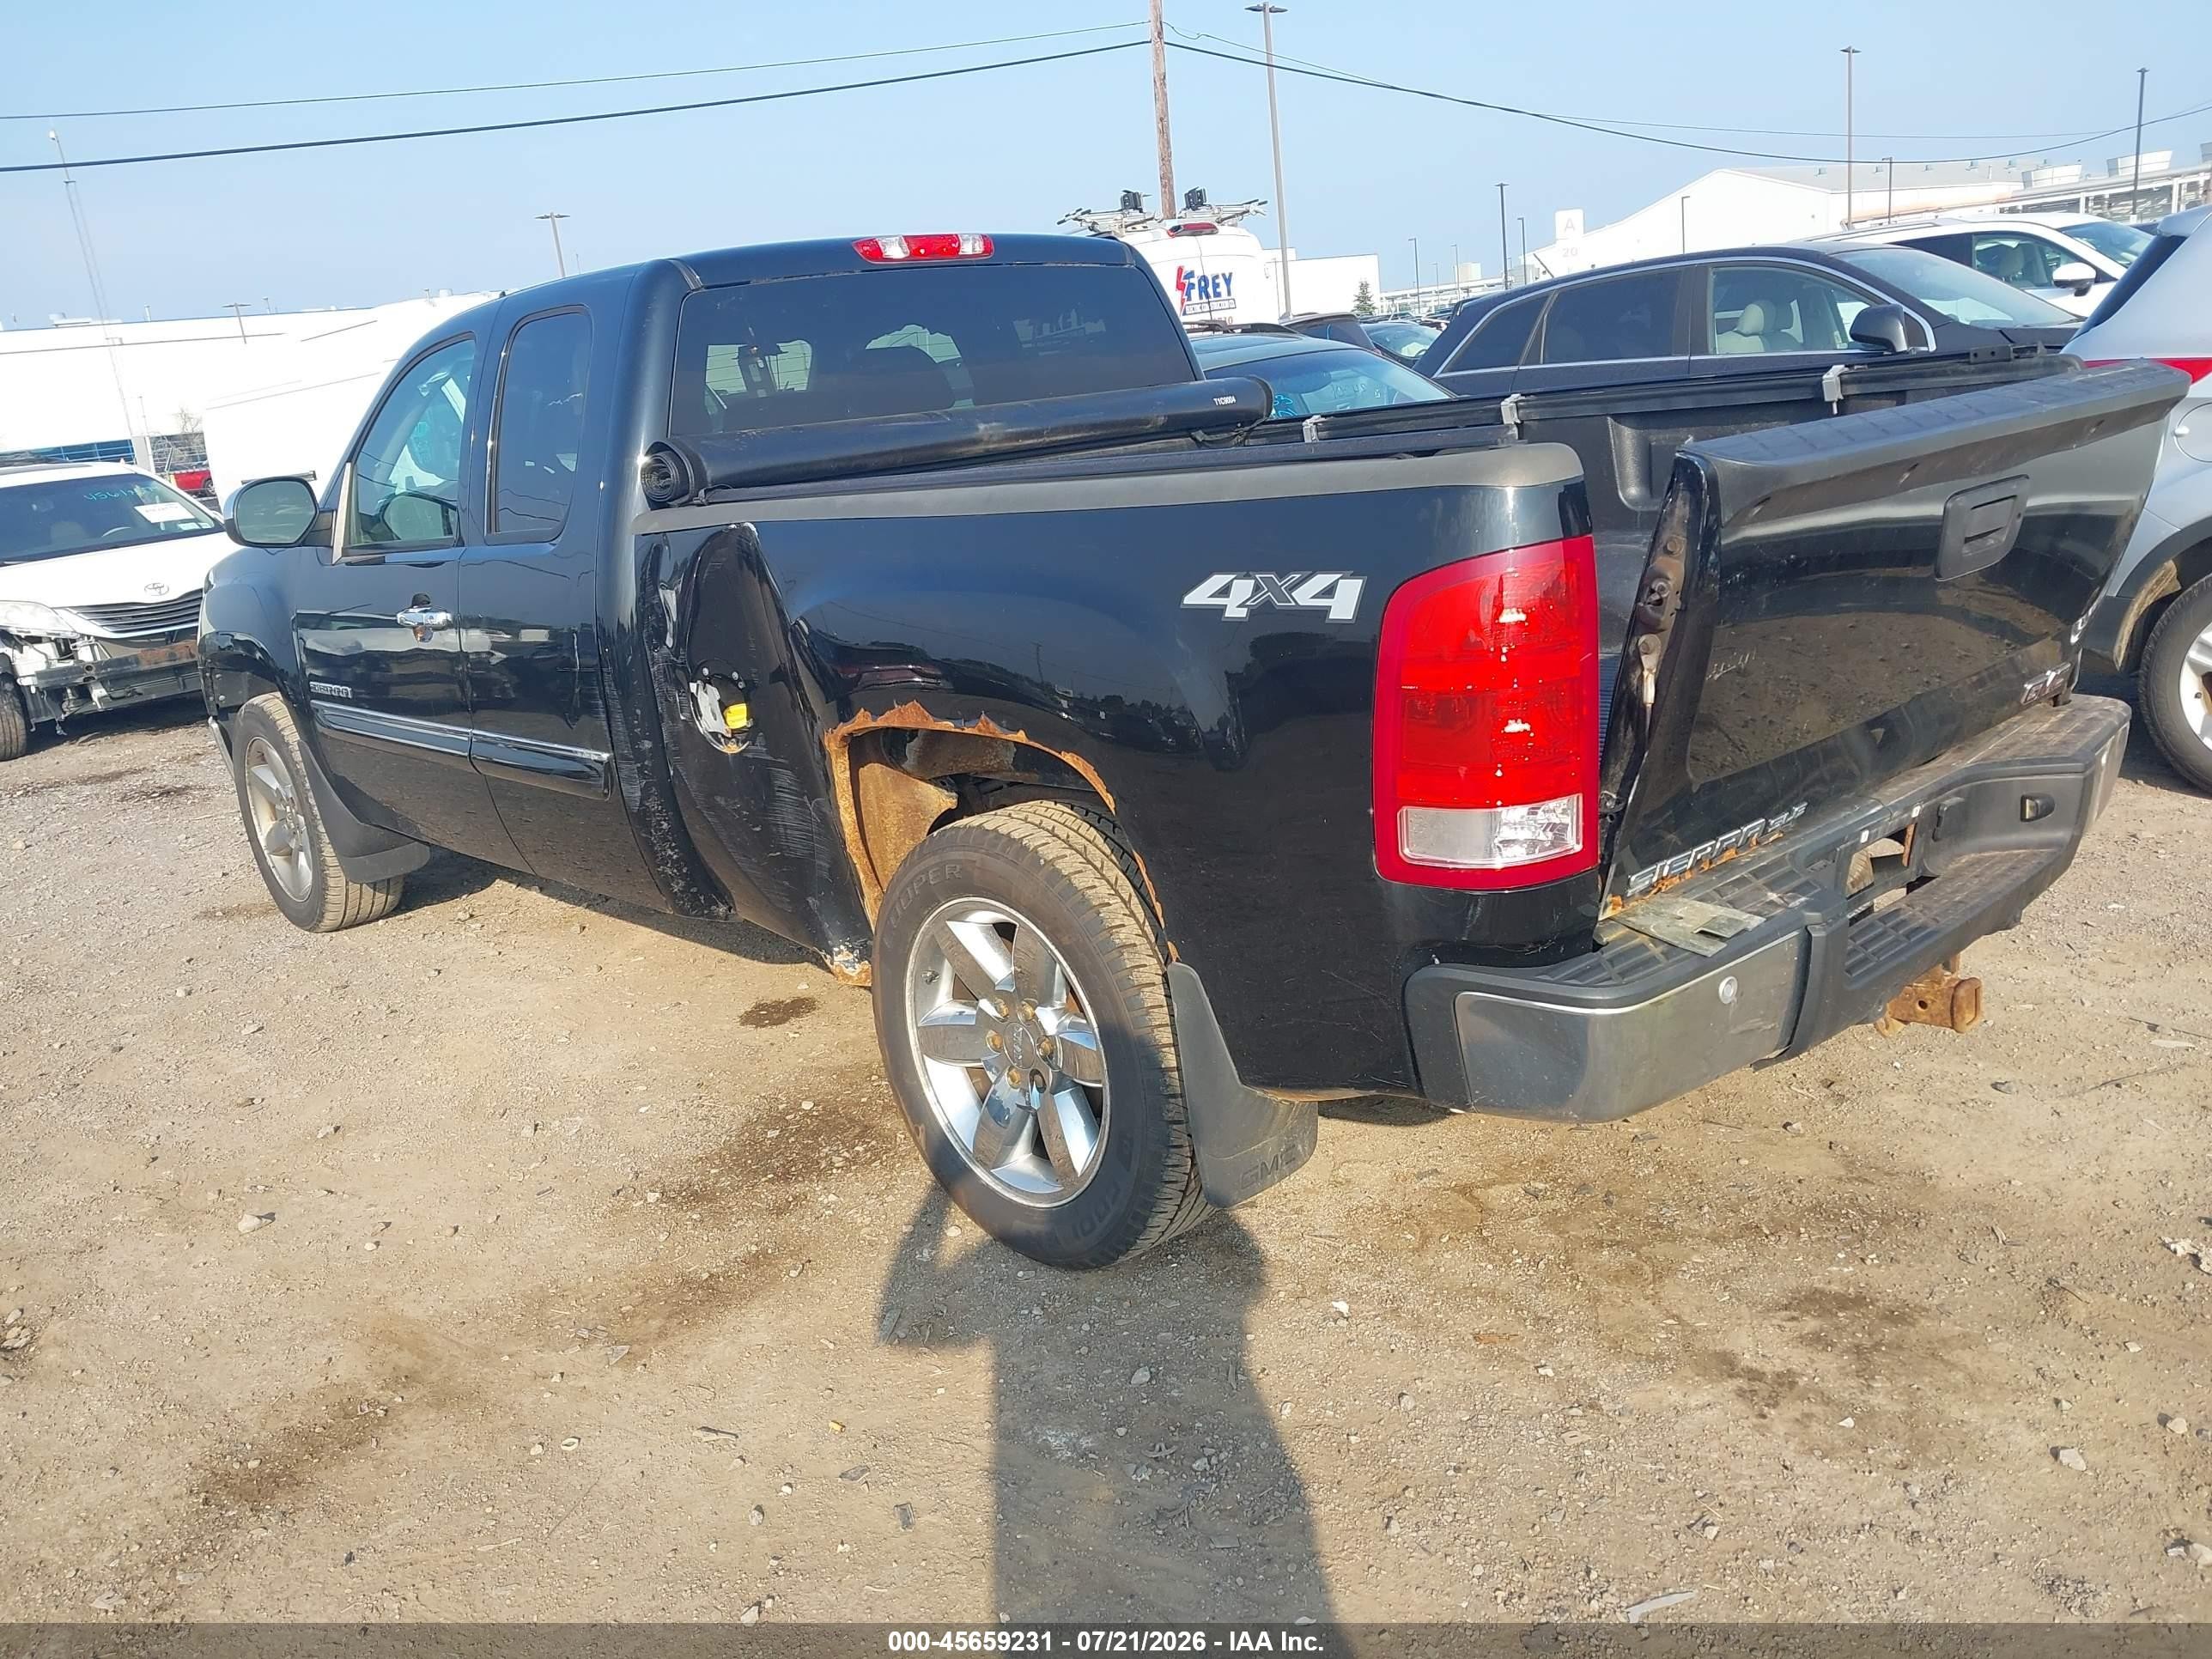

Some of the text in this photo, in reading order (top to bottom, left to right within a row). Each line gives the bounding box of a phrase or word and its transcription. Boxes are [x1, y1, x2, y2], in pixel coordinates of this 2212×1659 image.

[1563, 217, 1576, 234] A
[1182, 270, 1233, 301] FREY
[1626, 817, 1766, 897] SIERRA
